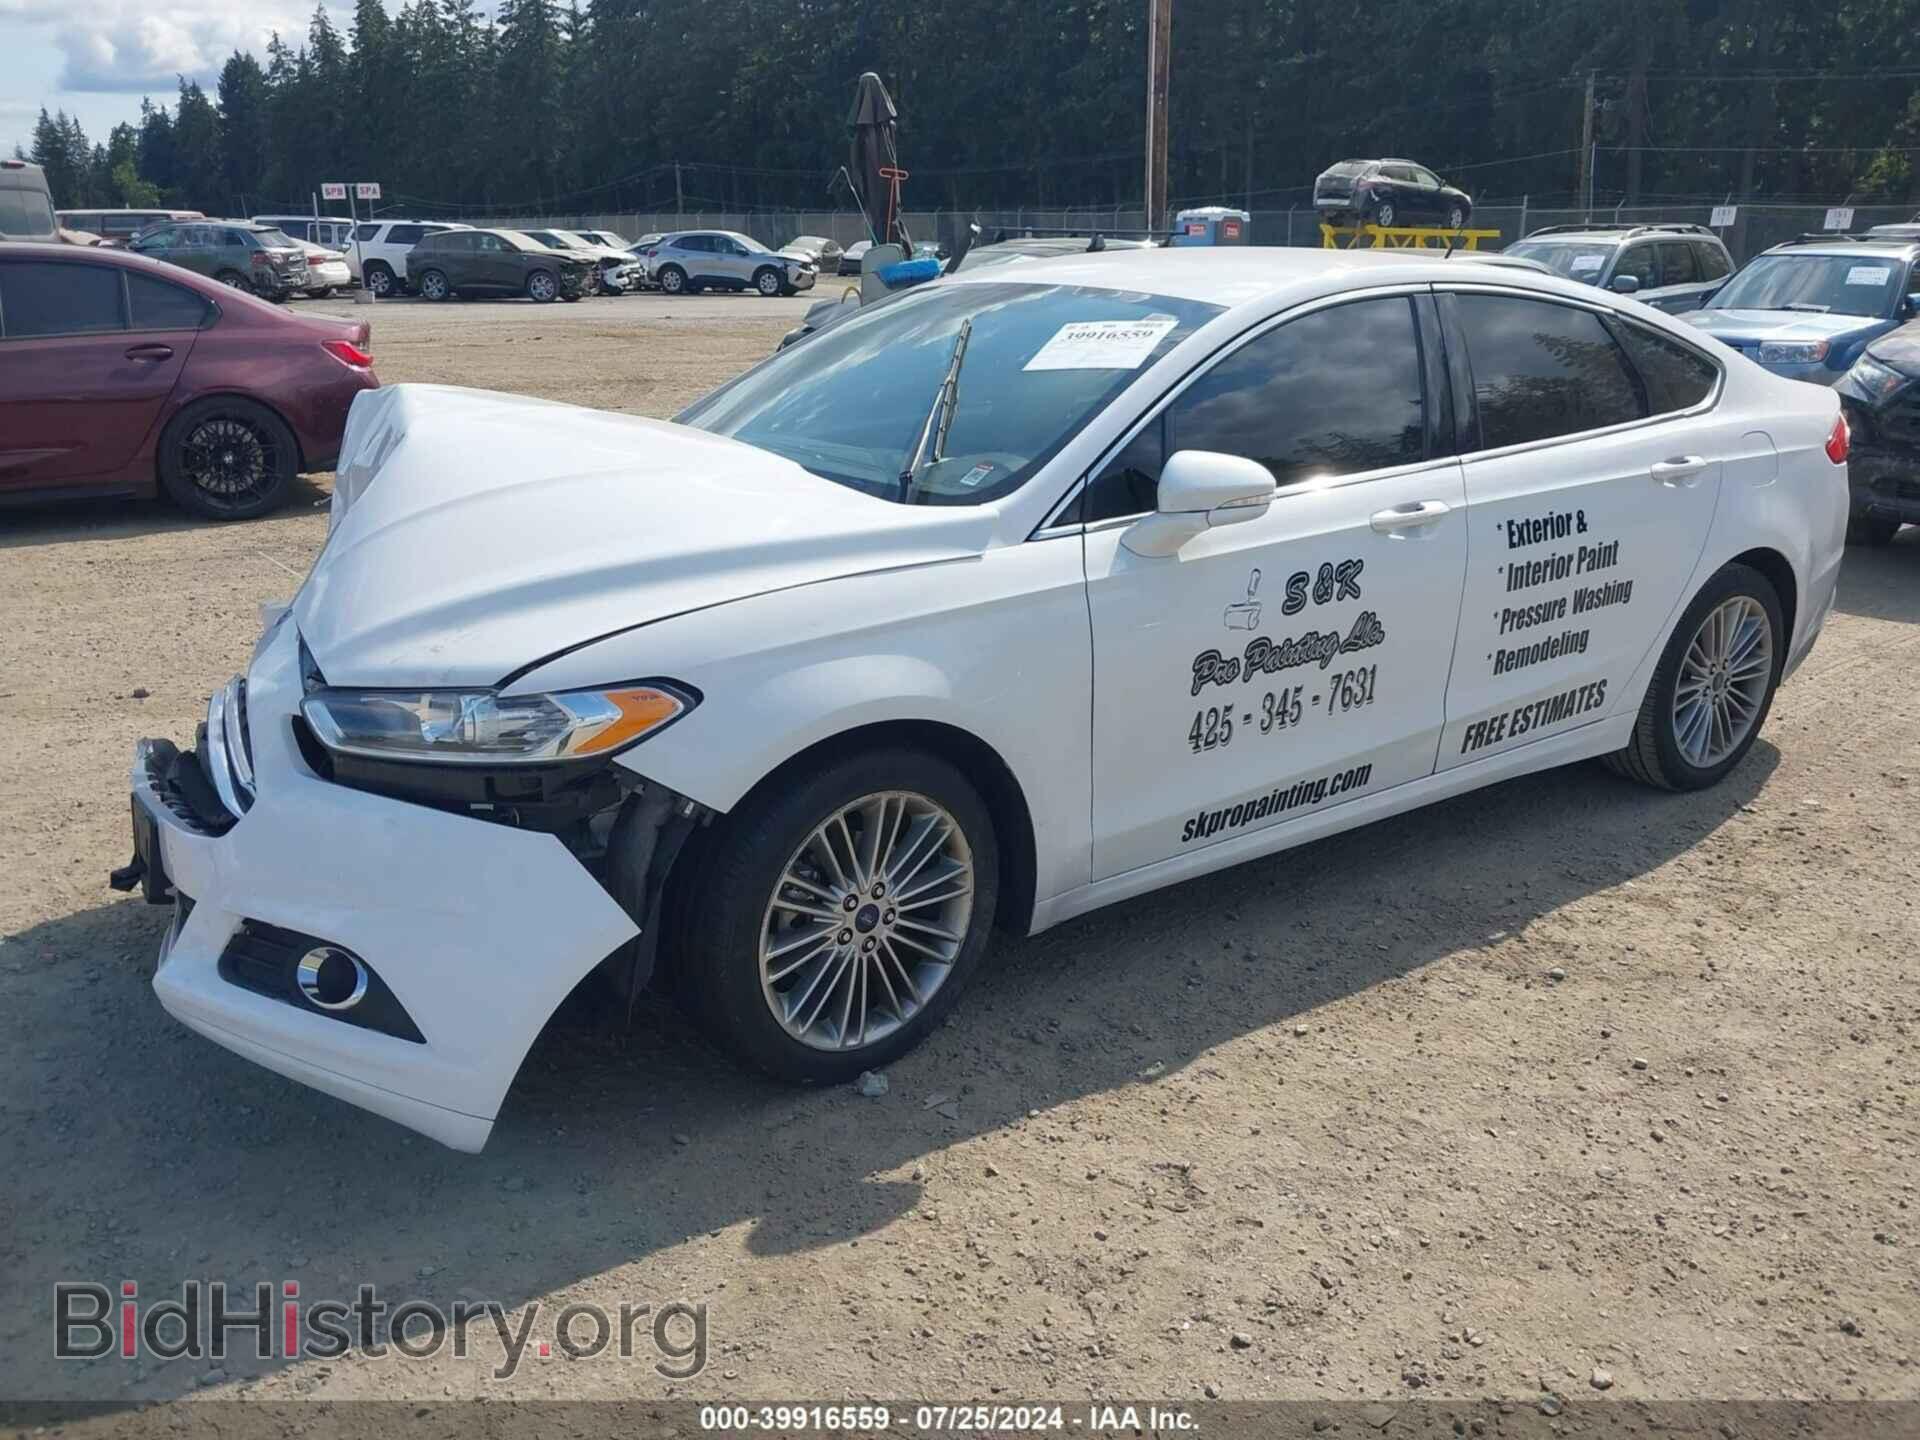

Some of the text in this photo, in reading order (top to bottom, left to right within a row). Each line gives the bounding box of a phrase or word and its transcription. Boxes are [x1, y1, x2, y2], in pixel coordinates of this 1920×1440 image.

[359, 186, 377, 195] SPA
[1507, 510, 1588, 549] Exterior &
[1506, 540, 1619, 592] Interior Paint
[1500, 580, 1634, 635] Pressure Washing
[1191, 649, 1240, 696] Pro
[1243, 631, 1340, 683] Painting
[1493, 629, 1589, 675] Remodeling
[1188, 703, 1234, 754] 425
[1260, 685, 1303, 735] 345
[1328, 664, 1377, 716] 7631
[1461, 679, 1608, 754] FREE ESTIMATES
[1181, 763, 1373, 842] skpropainting.com
